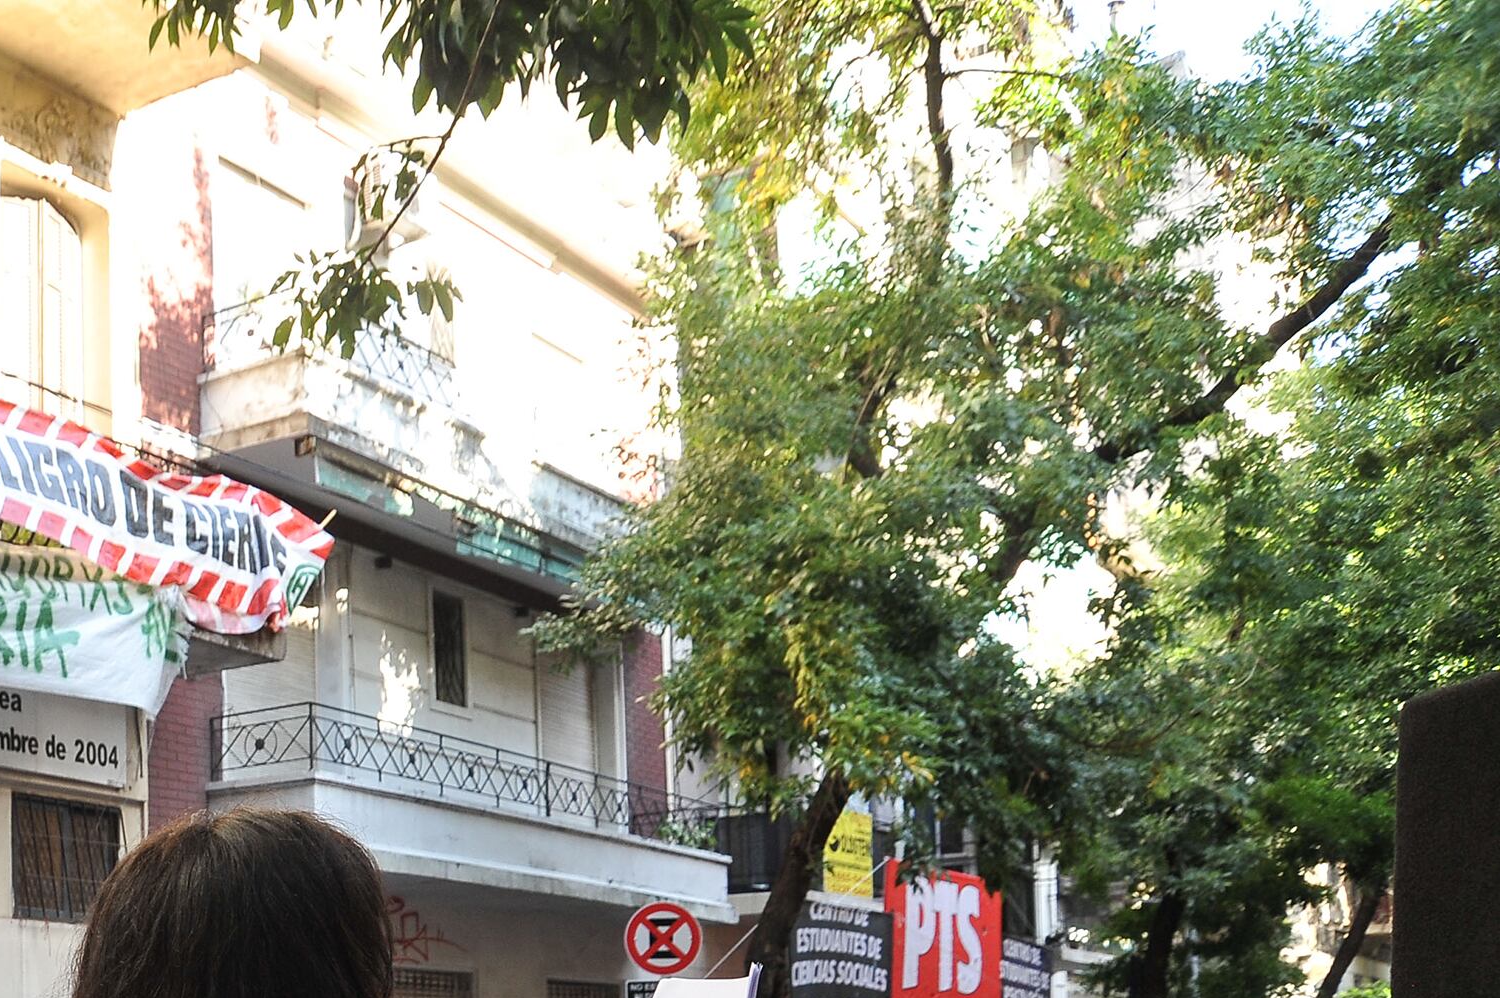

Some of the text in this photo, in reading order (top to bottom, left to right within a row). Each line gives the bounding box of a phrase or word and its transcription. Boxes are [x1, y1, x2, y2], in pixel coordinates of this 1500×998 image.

[119, 469, 175, 547] DE
[45, 734, 67, 761] de
[74, 738, 119, 770] 2004
[902, 876, 982, 996] PTS
